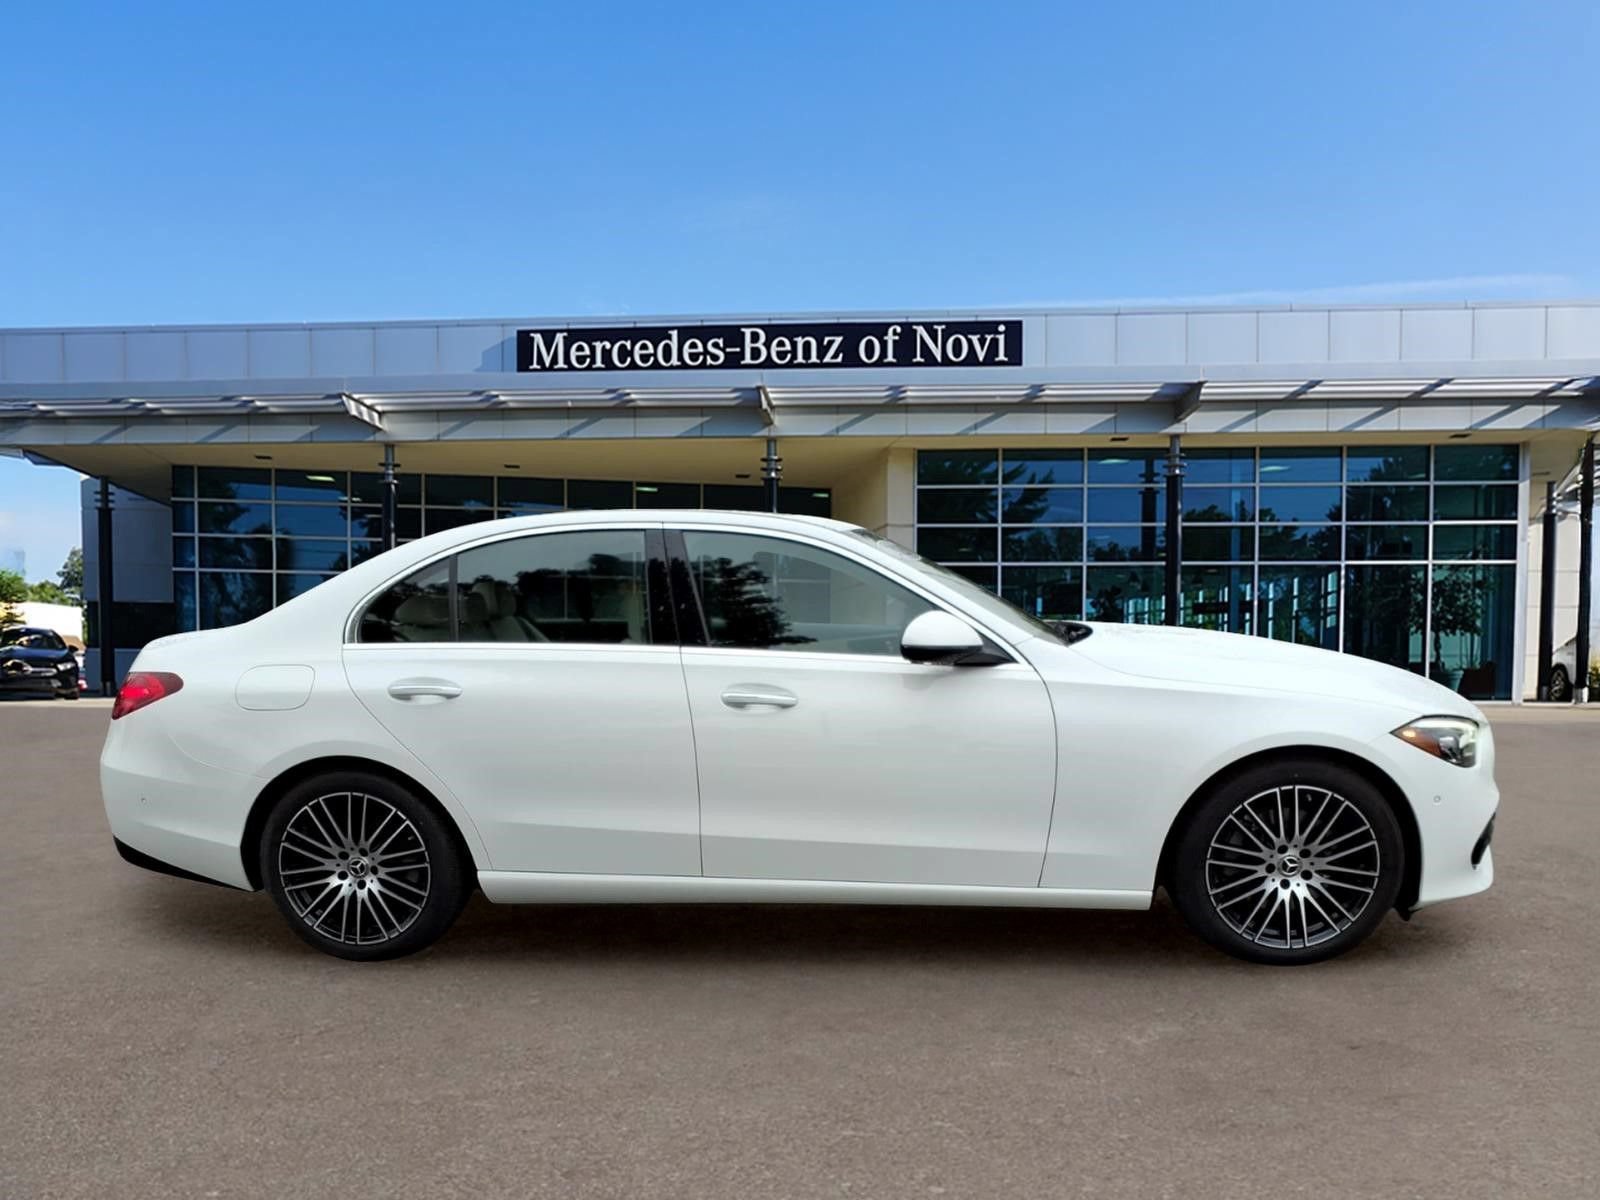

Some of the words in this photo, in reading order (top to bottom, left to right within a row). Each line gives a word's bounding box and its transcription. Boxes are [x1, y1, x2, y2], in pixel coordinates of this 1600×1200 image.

[529, 327, 843, 369] Mercedes-Benz
[858, 325, 902, 364] of
[912, 324, 1009, 363] Novi
